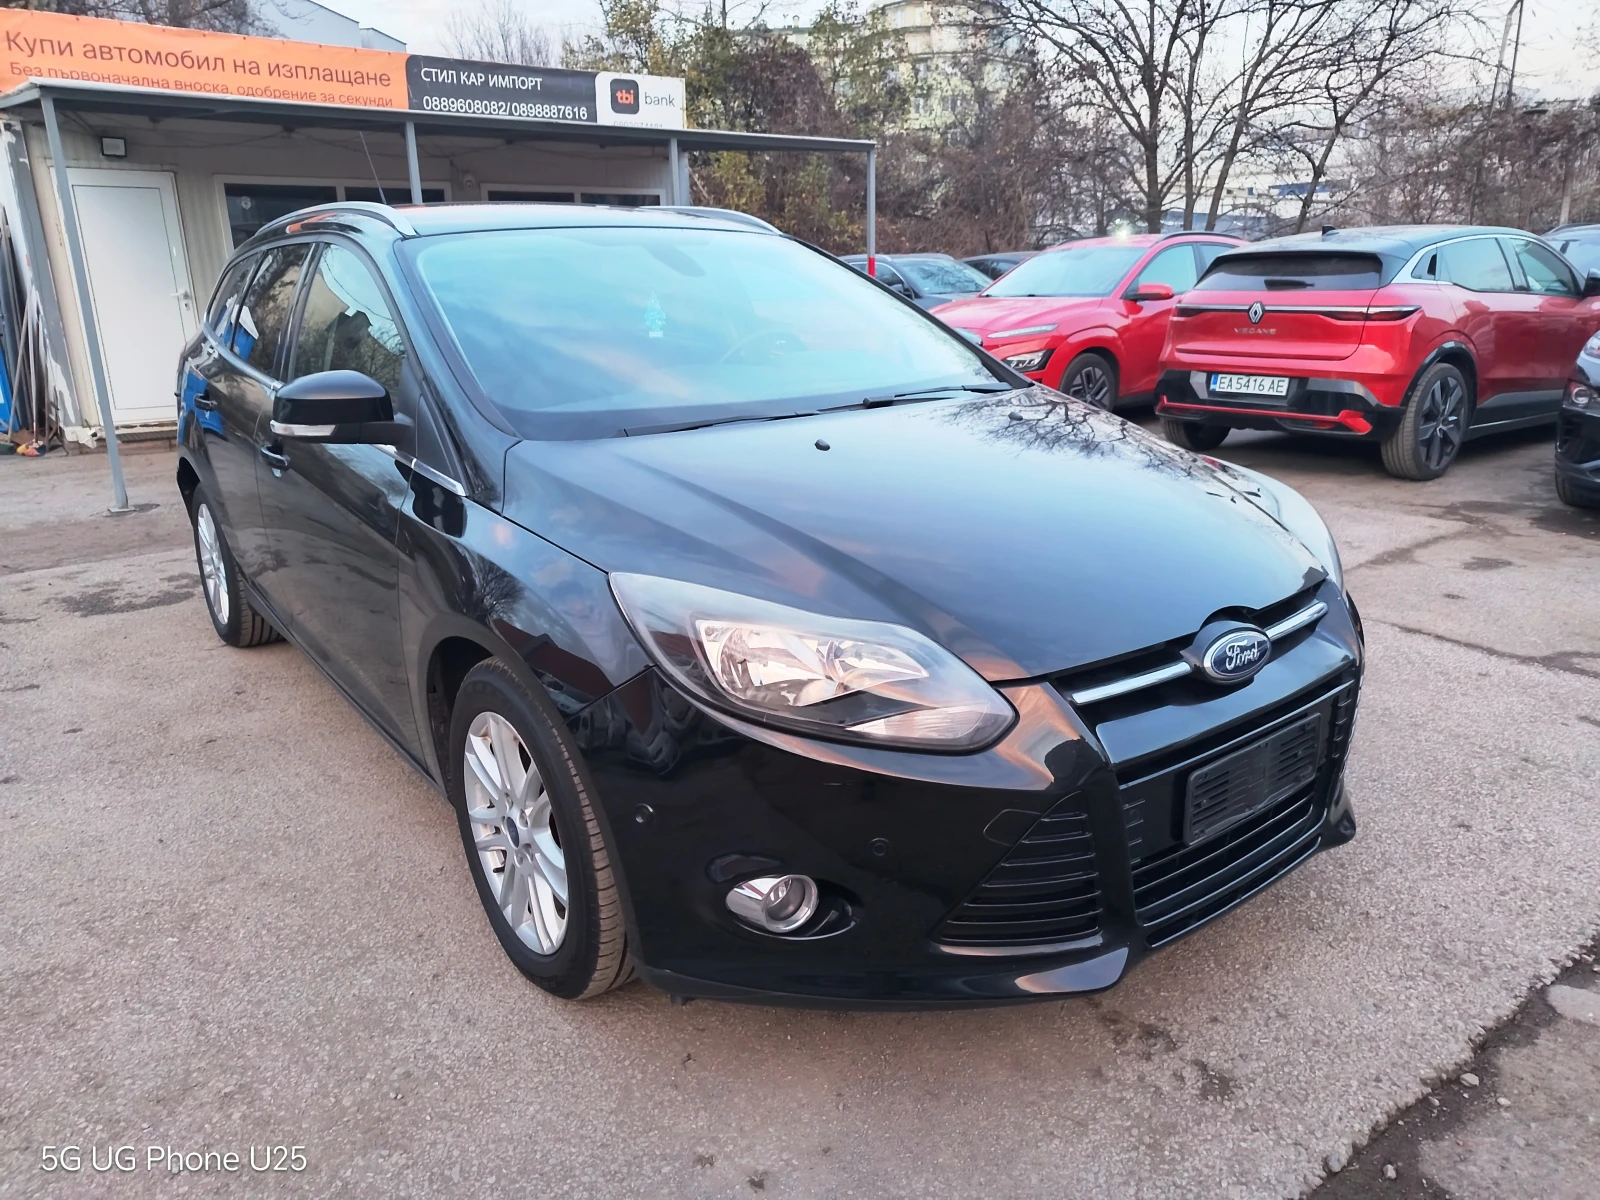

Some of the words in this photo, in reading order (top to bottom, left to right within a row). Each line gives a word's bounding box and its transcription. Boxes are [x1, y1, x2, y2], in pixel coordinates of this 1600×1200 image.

[6, 30, 73, 57] Купи
[82, 42, 226, 73] автомобил
[233, 60, 261, 76] на
[268, 63, 392, 88] изплащане
[10, 62, 43, 77] Без
[237, 84, 317, 101] одобрение
[320, 92, 335, 103] за
[339, 94, 393, 108] секунди
[421, 67, 457, 84] СТИЛ
[460, 71, 485, 87] КАР
[488, 74, 543, 91] ИМПОРТ
[423, 95, 588, 120] 0889608082/0898887616
[616, 89, 634, 105] tbi
[644, 92, 676, 107] bank
[1225, 639, 1260, 671] Ford
